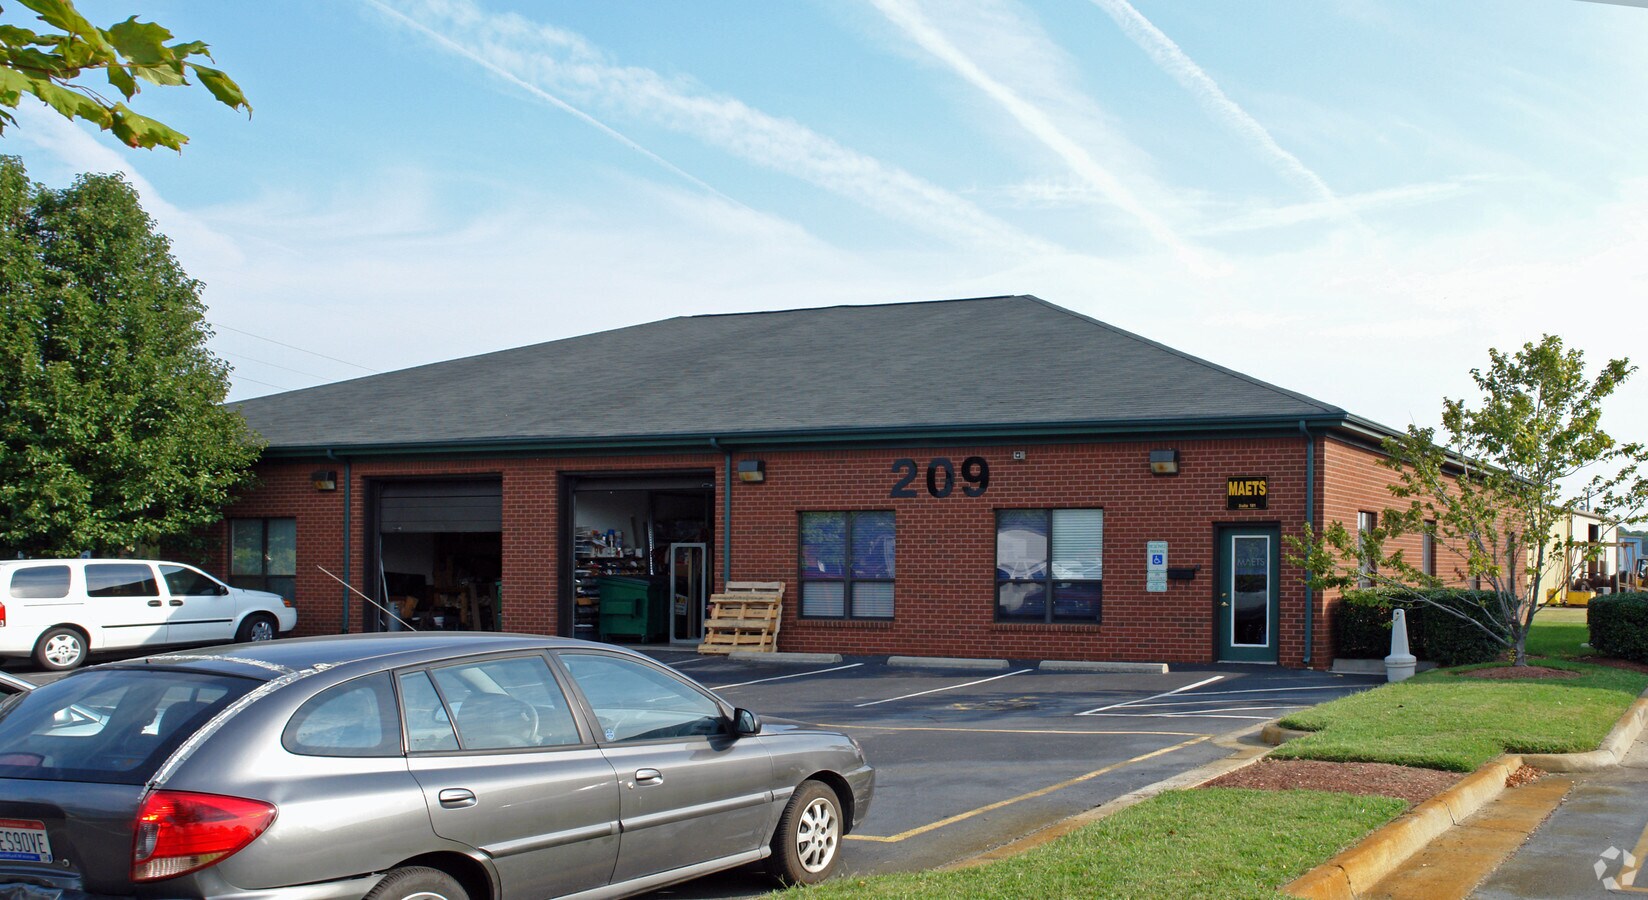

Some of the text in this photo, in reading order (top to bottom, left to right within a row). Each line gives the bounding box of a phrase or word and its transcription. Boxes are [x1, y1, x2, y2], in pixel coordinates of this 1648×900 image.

[890, 456, 989, 498] 209
[1228, 480, 1266, 496] MAETS
[1237, 558, 1265, 566] MAETS
